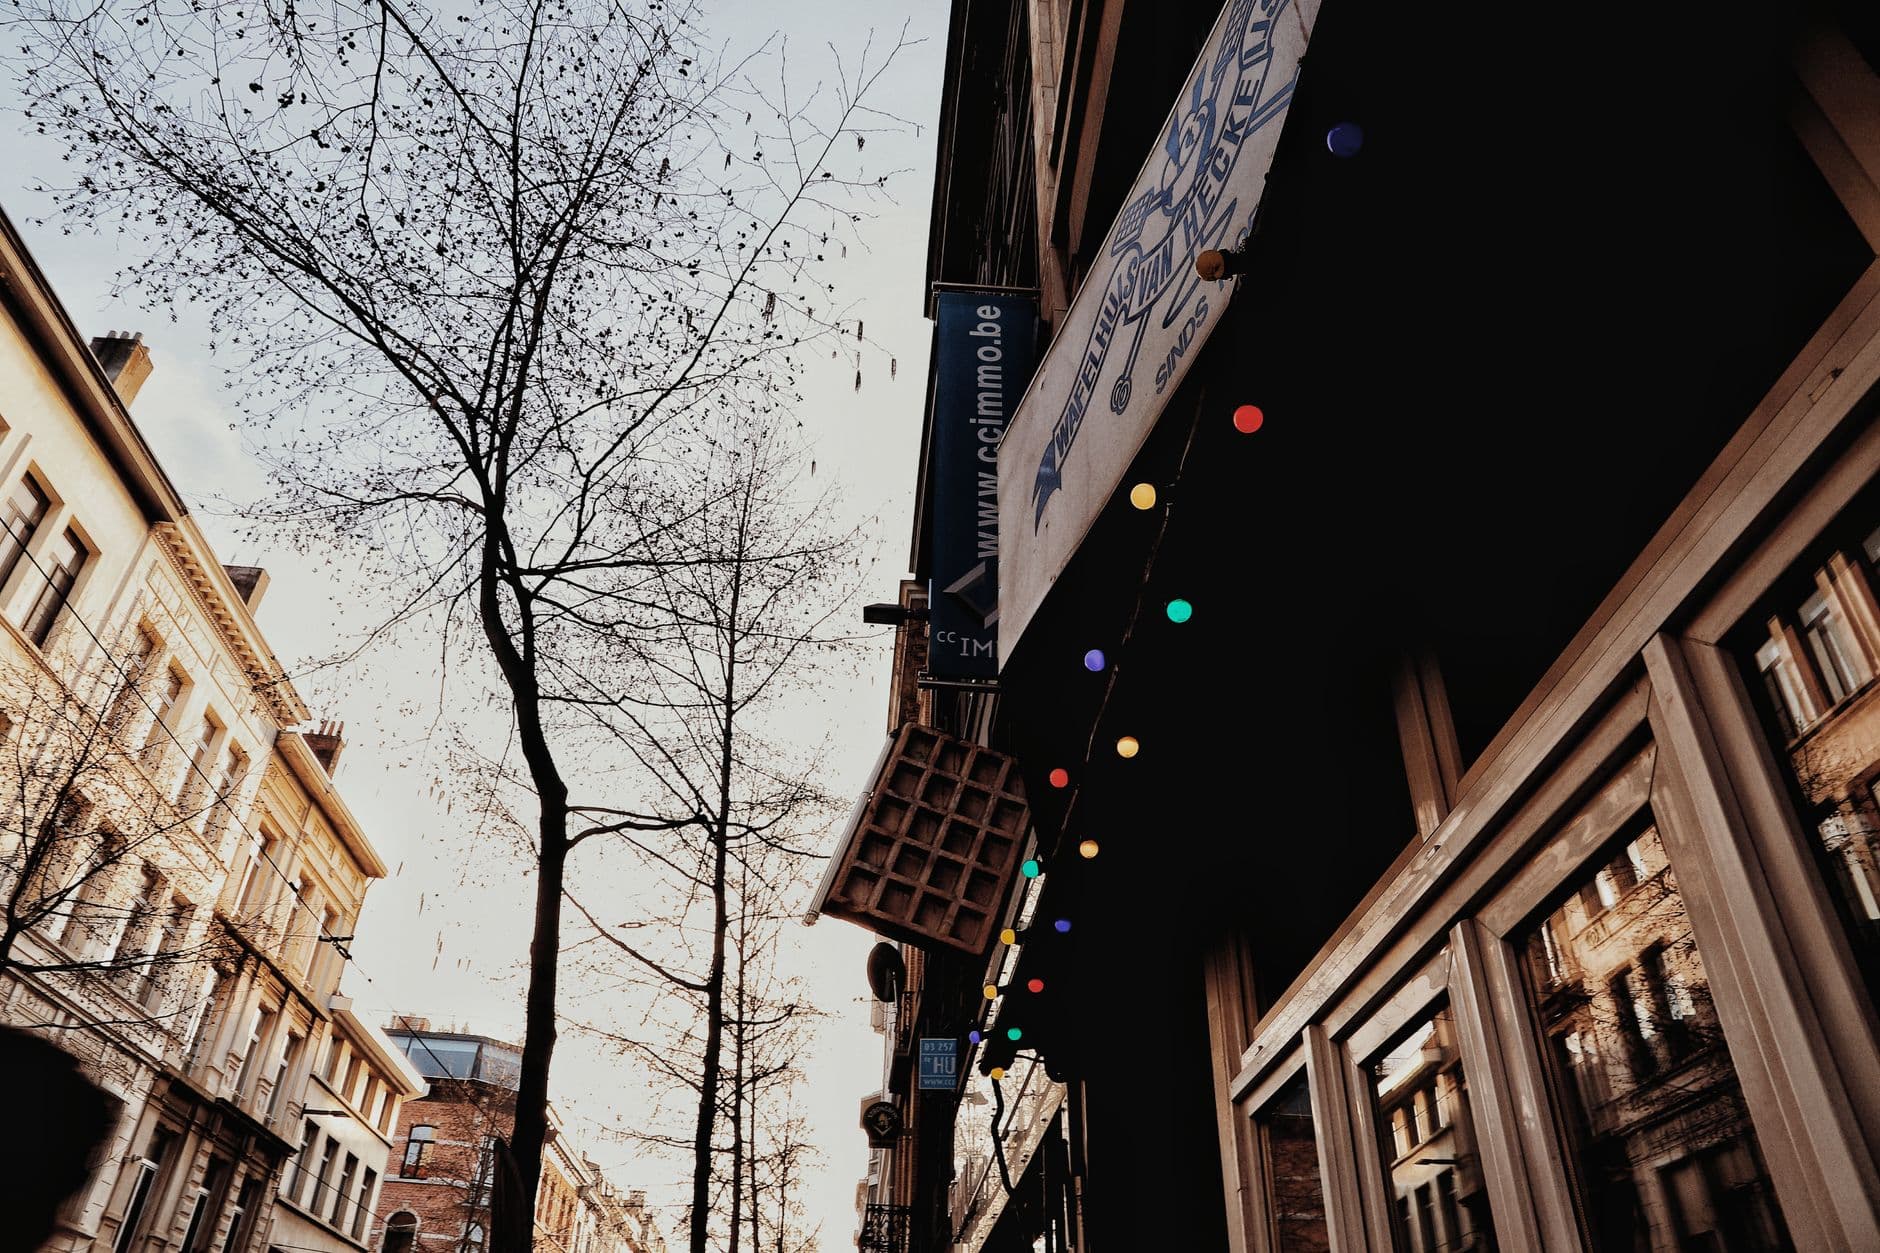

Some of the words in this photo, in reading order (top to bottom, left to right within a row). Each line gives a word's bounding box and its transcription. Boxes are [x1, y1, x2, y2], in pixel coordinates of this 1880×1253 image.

[1055, 256, 1138, 458] WAFELHUIS
[1138, 234, 1174, 307] VAN
[1183, 79, 1259, 250] HECKE
[1155, 295, 1209, 395] SINDS
[968, 305, 1003, 559] wwwccimmo.be
[959, 636, 993, 659] IM
[933, 1056, 956, 1075] HU
